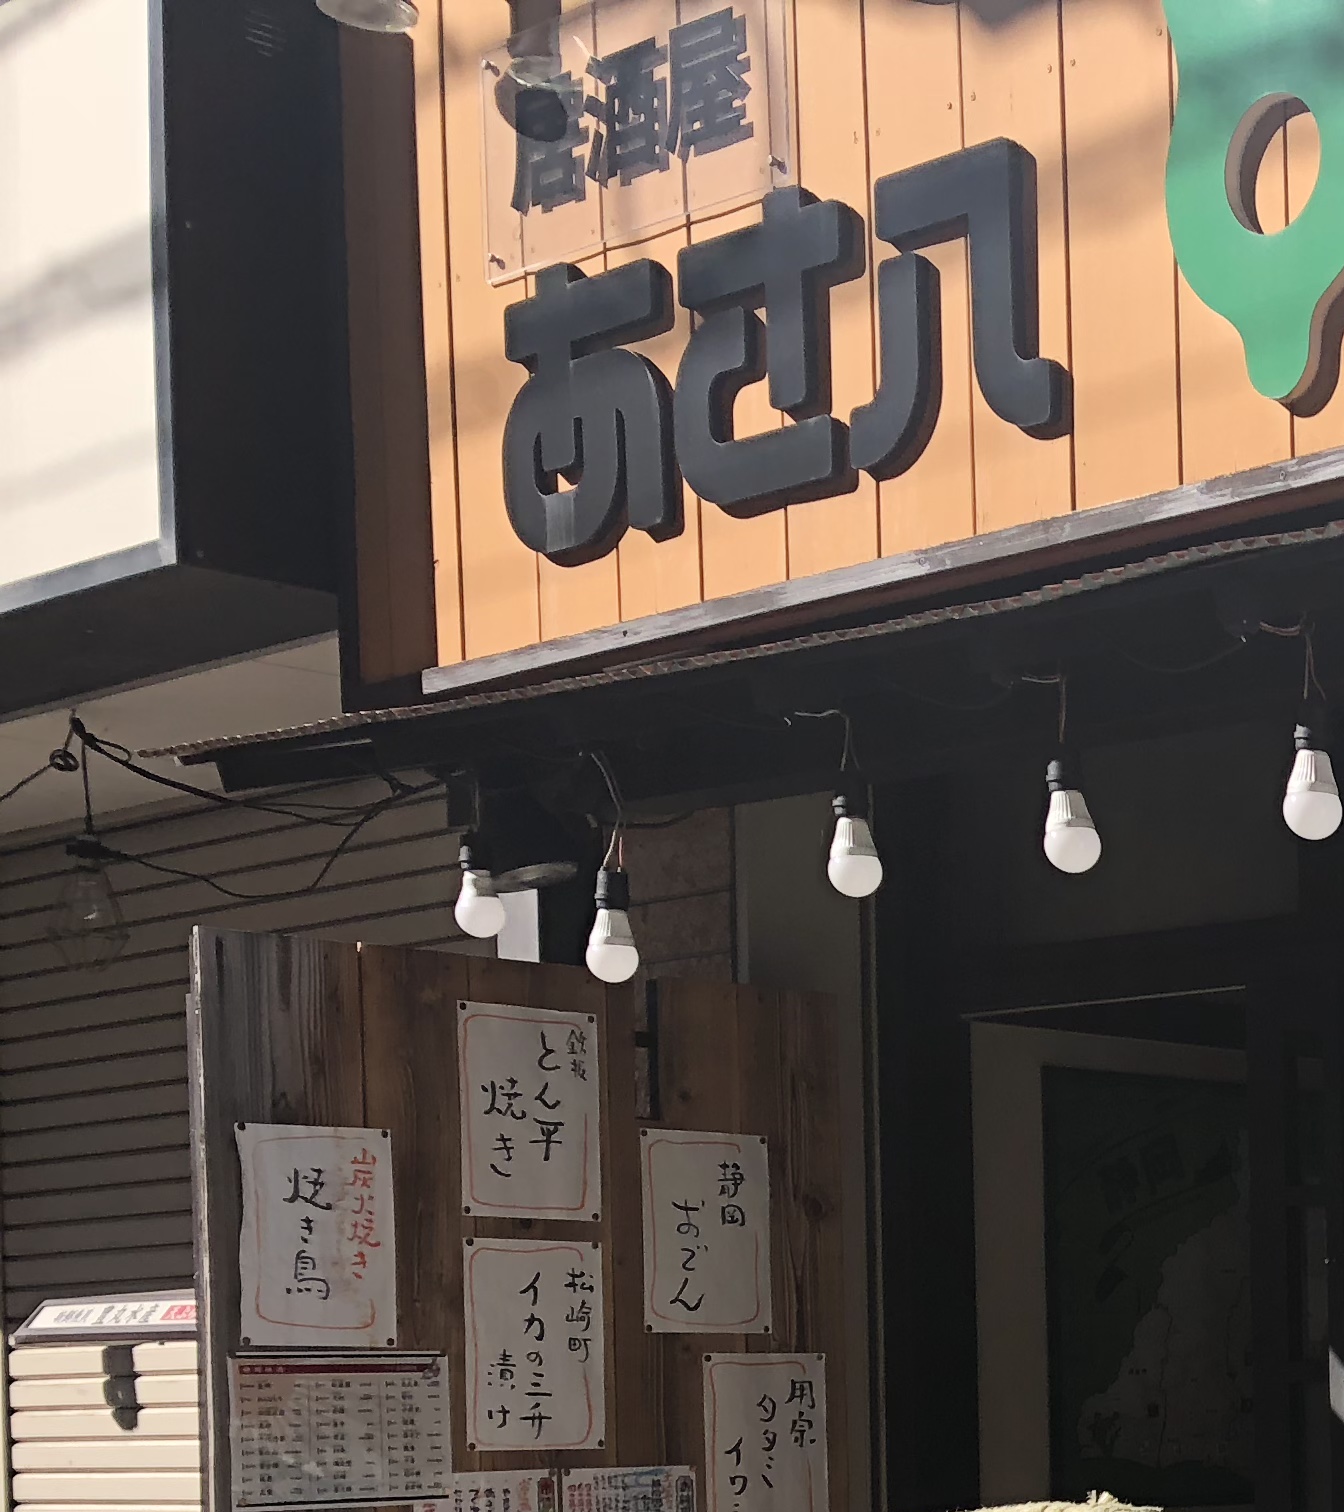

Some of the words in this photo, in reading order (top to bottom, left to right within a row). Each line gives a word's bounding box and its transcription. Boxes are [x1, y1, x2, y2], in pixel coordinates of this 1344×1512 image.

[503, 136, 1074, 568] あさ八
[481, 1077, 527, 1178] 焼き
[529, 1031, 565, 1161] とん平
[285, 1167, 332, 1301] 焼き鳥
[716, 1160, 746, 1228] 静岡
[669, 1199, 704, 1312] おでん
